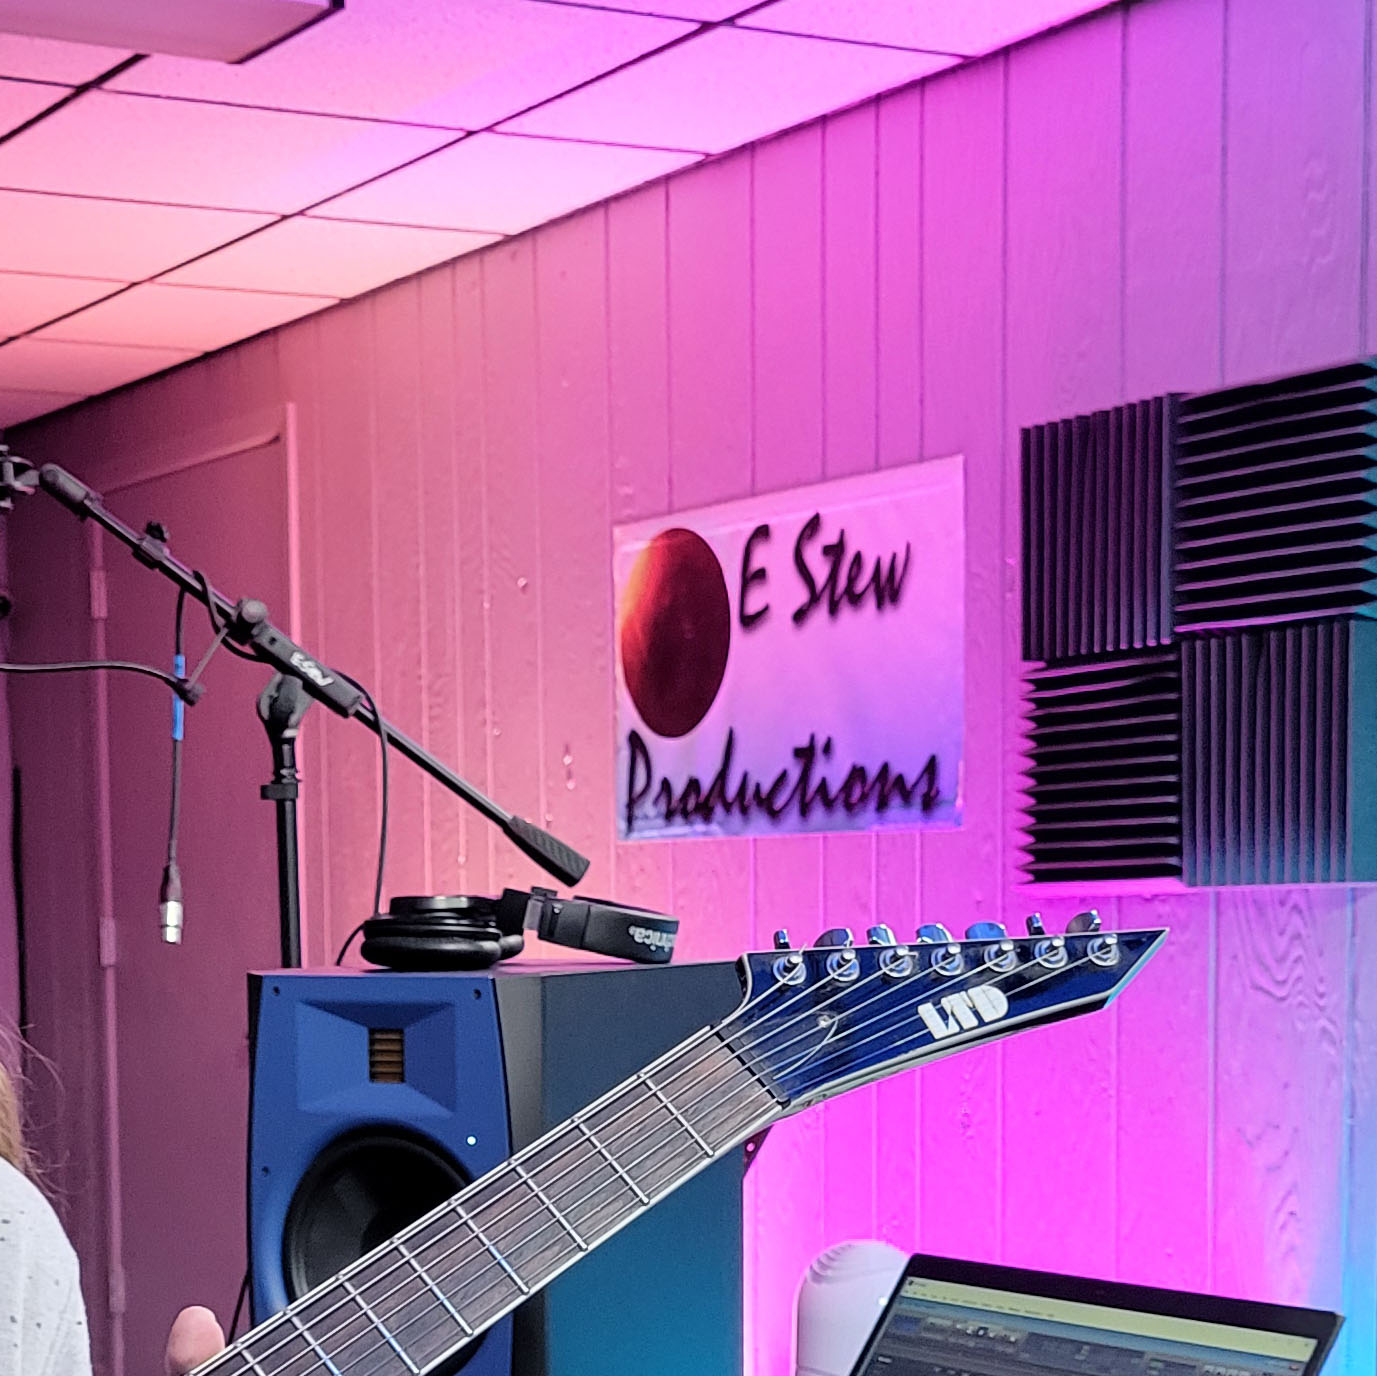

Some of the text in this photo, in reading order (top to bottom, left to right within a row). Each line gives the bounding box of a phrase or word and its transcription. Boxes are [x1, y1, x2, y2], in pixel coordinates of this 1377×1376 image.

[739, 511, 912, 631] E Stew
[625, 726, 941, 838] Productions
